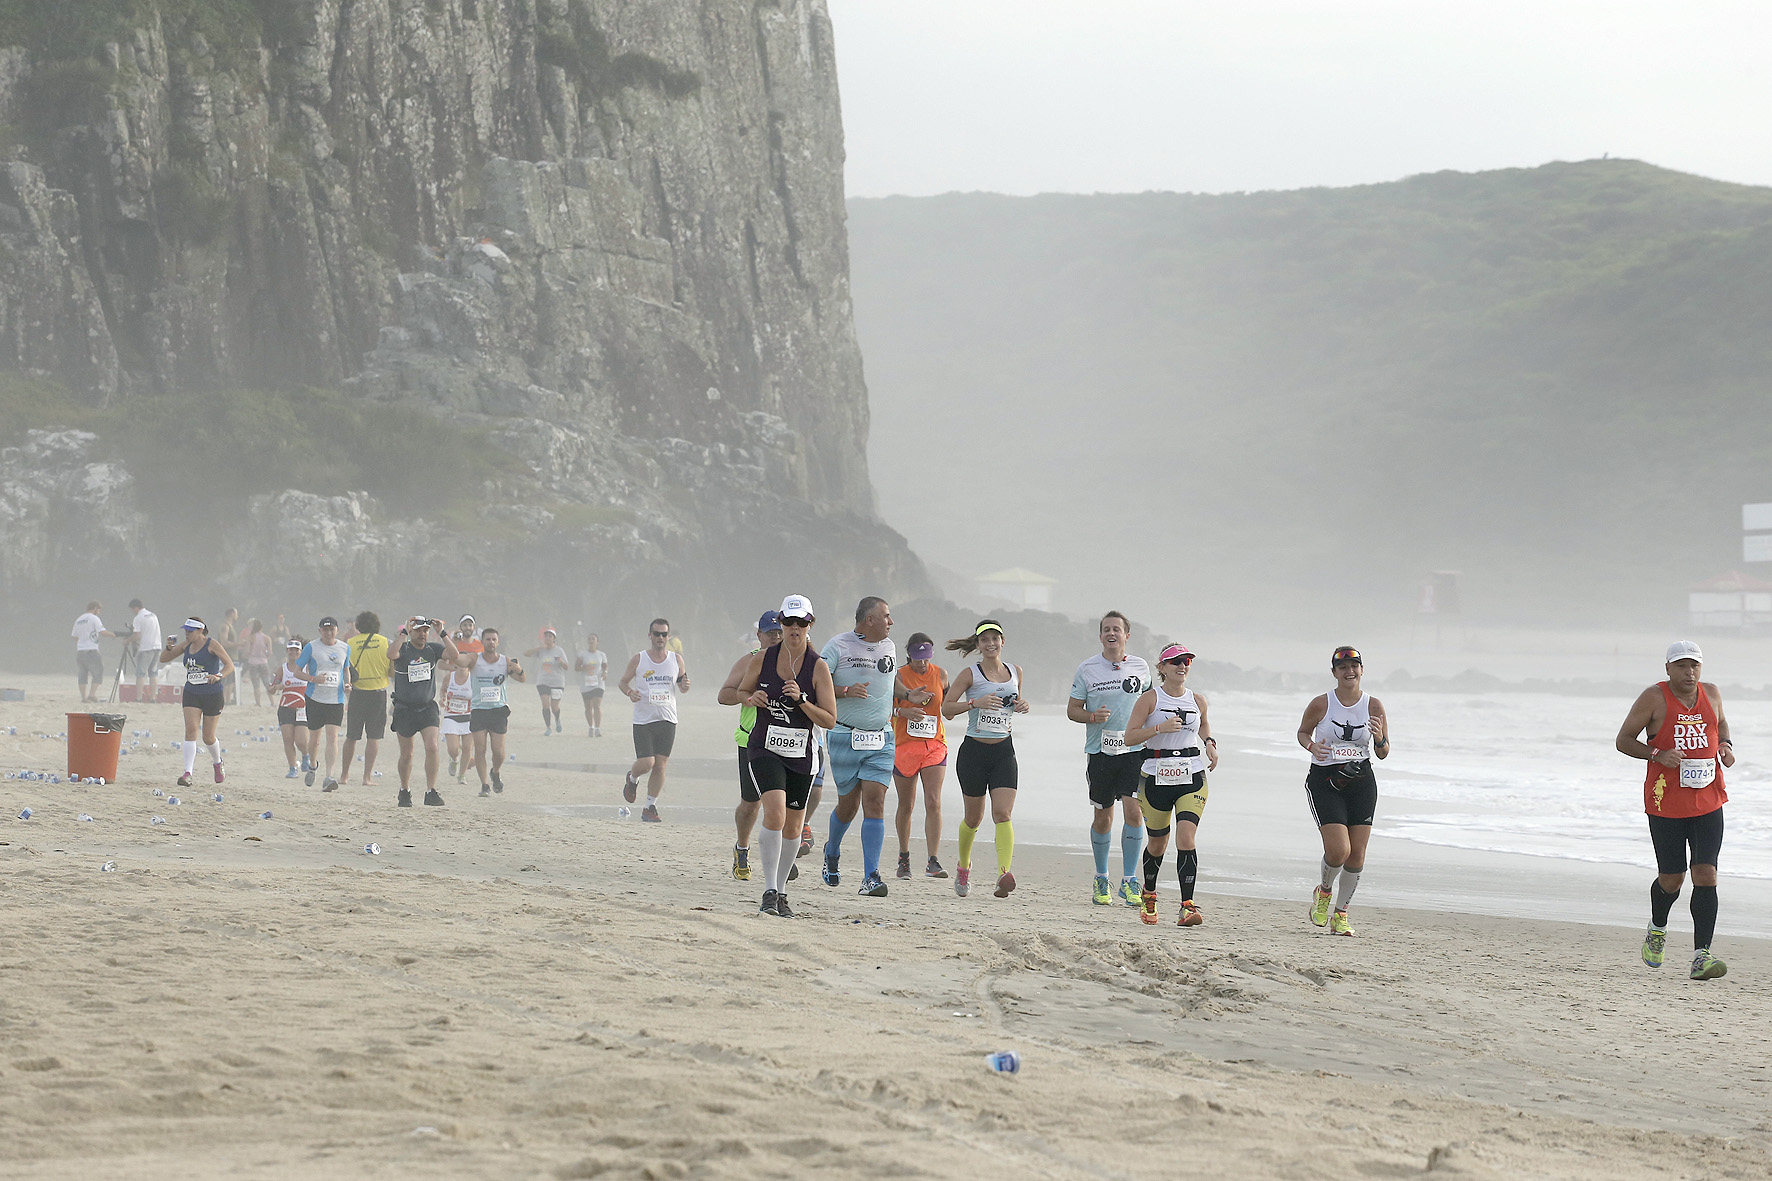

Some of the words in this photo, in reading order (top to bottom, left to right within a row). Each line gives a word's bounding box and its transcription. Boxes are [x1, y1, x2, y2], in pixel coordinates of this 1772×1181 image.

[1092, 679, 1122, 688] Companhia
[980, 714, 1008, 724] 8033-1
[910, 722, 934, 730] 8097-1
[1674, 723, 1708, 738] DAY
[770, 736, 804, 748] 8098-1
[854, 734, 882, 742] 2017-1
[1674, 736, 1709, 750] RUN
[1336, 748, 1364, 757] 4202-1
[1160, 768, 1188, 777] 4200-1
[1684, 769, 1714, 778] 2074-1
